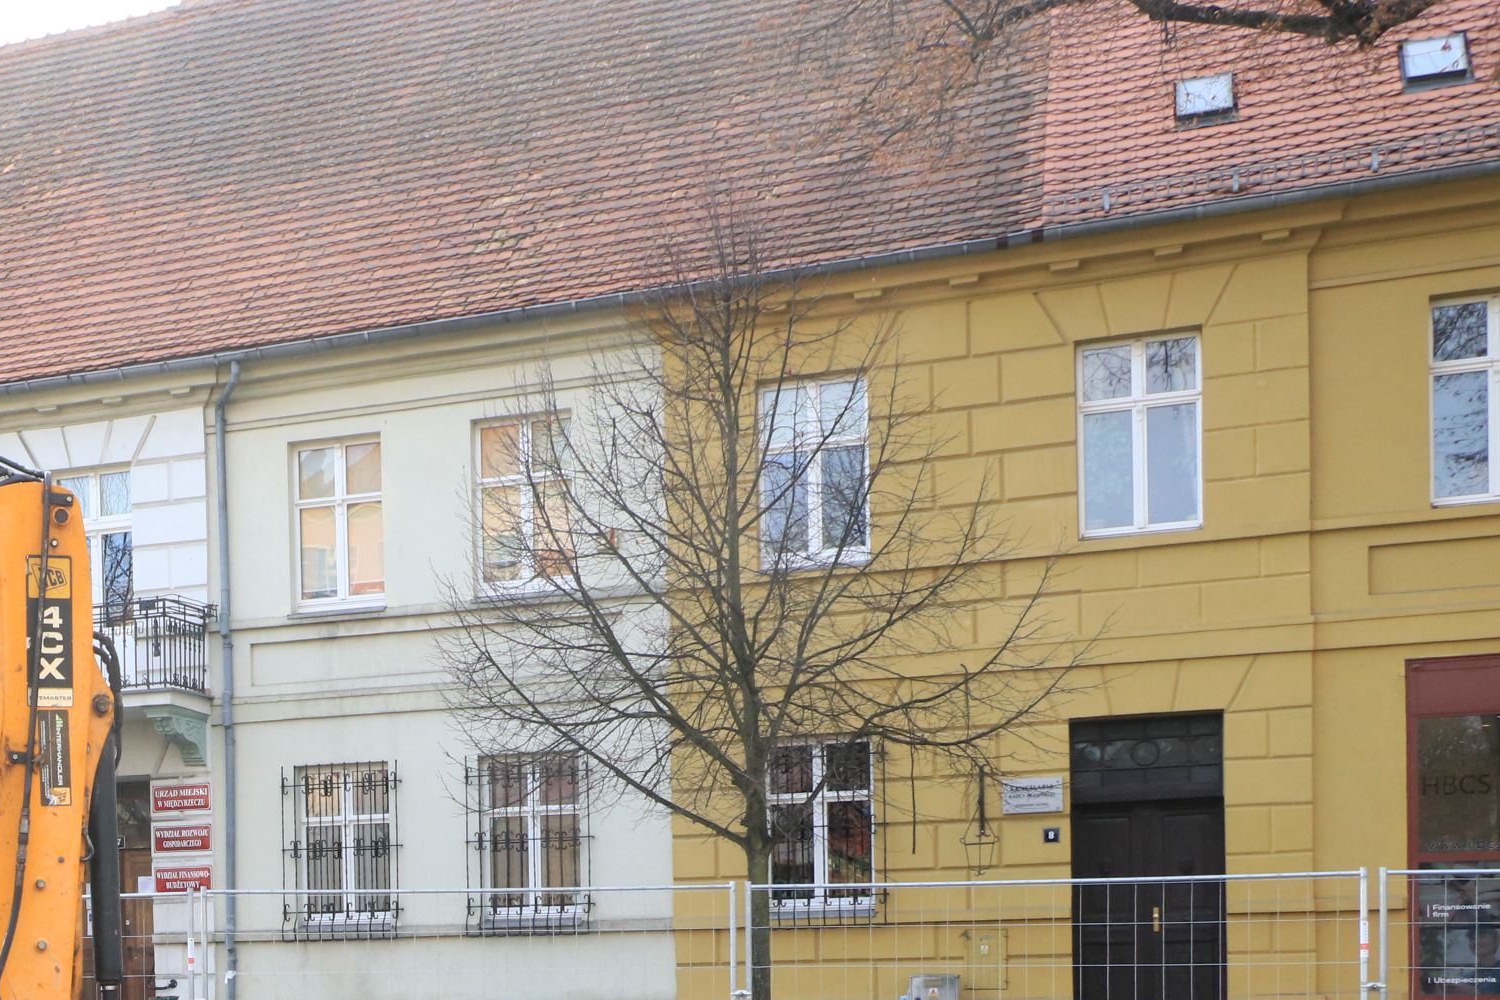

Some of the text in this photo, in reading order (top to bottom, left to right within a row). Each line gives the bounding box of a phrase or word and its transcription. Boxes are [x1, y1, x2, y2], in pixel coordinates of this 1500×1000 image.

[39, 606, 65, 680] 4CX
[55, 727, 64, 786] INTERHANDLER
[180, 788, 207, 796] MIEJSKI
[1422, 774, 1491, 796] HBCS
[164, 799, 205, 808] MIĘDZYRZECZU
[1048, 831, 1055, 839] 8
